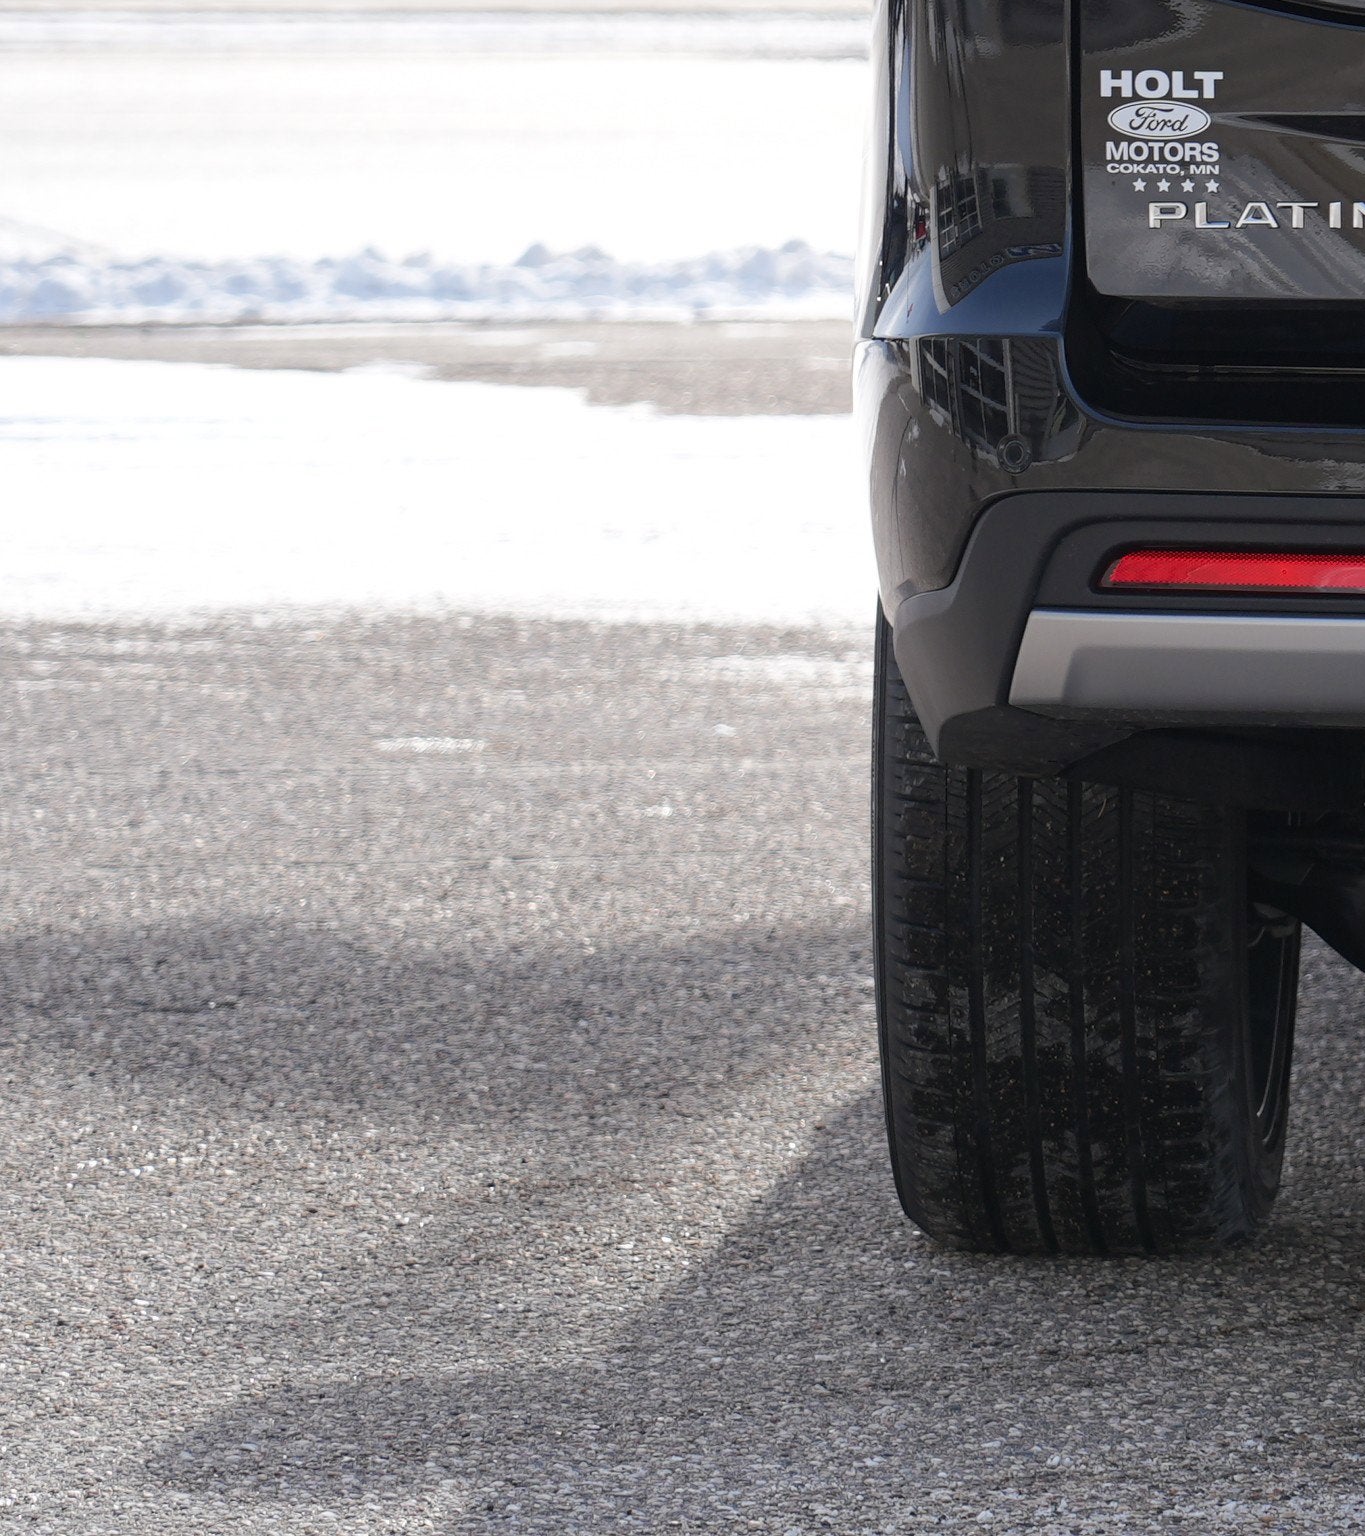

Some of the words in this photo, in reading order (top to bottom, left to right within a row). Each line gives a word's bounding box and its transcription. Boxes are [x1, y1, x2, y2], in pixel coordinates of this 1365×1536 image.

[1100, 70, 1223, 98] HOLT
[1128, 109, 1189, 133] Ford
[1105, 141, 1220, 162] MOTORS
[1106, 164, 1186, 176] COKATO,
[1190, 164, 1220, 175] MN
